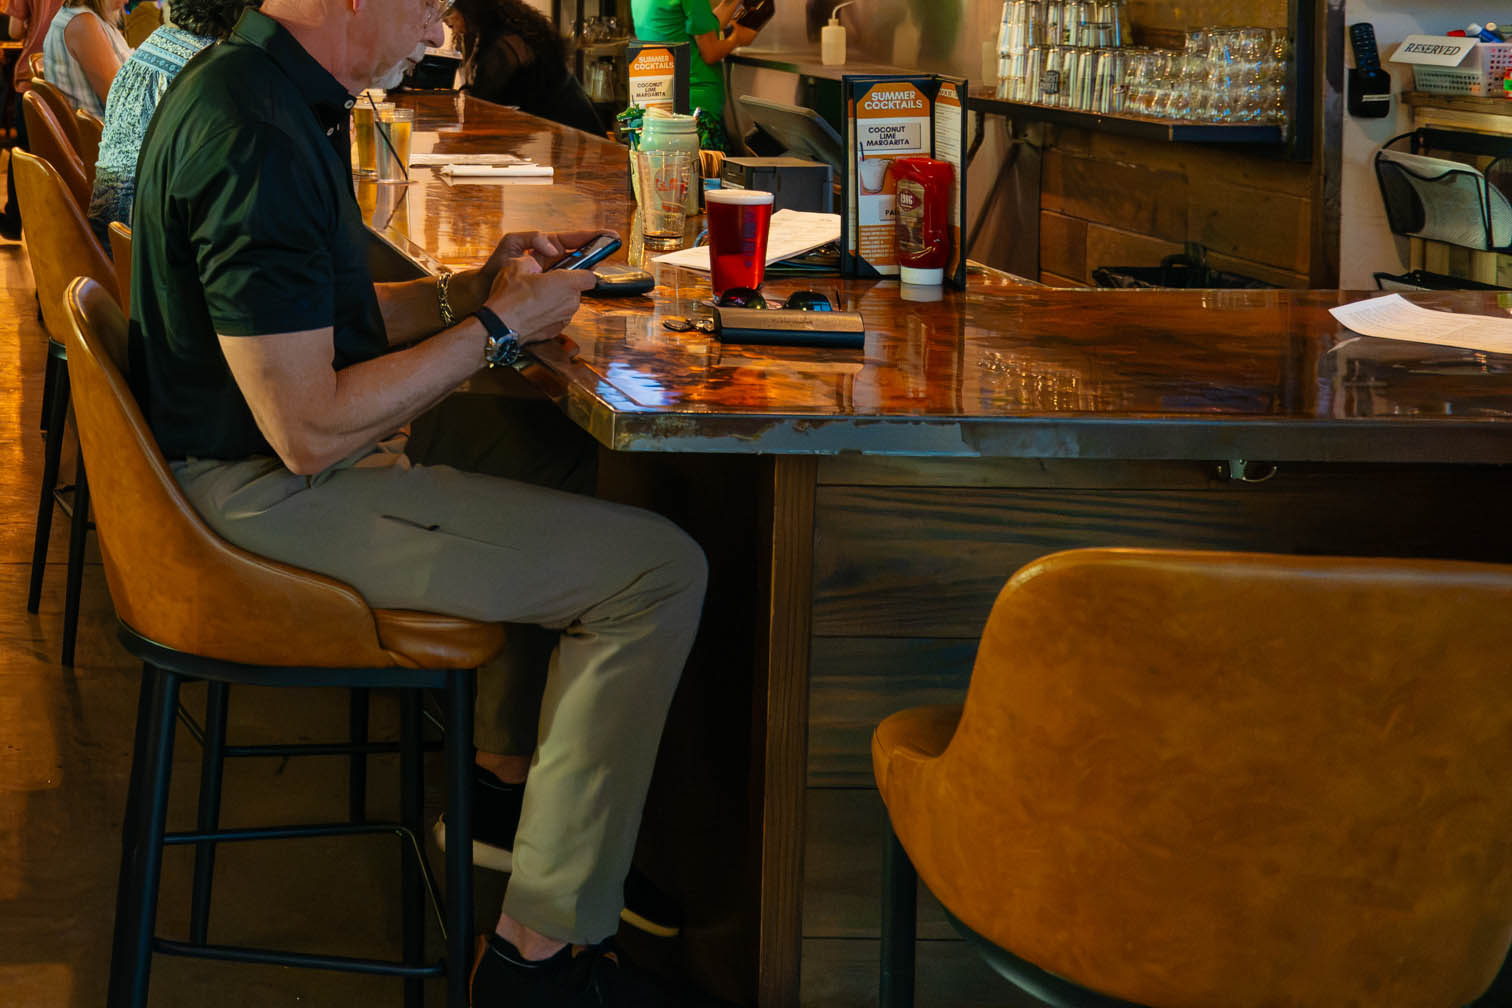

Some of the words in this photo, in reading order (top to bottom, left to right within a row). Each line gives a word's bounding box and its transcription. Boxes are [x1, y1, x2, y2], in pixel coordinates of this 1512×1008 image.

[1405, 42, 1461, 55] RESERVED
[634, 61, 673, 70] COCKTAILS
[871, 91, 916, 101] SUMMER
[864, 99, 923, 110] COCKTAILS
[868, 126, 905, 134] COCONUT
[866, 138, 910, 146] MARGARITA
